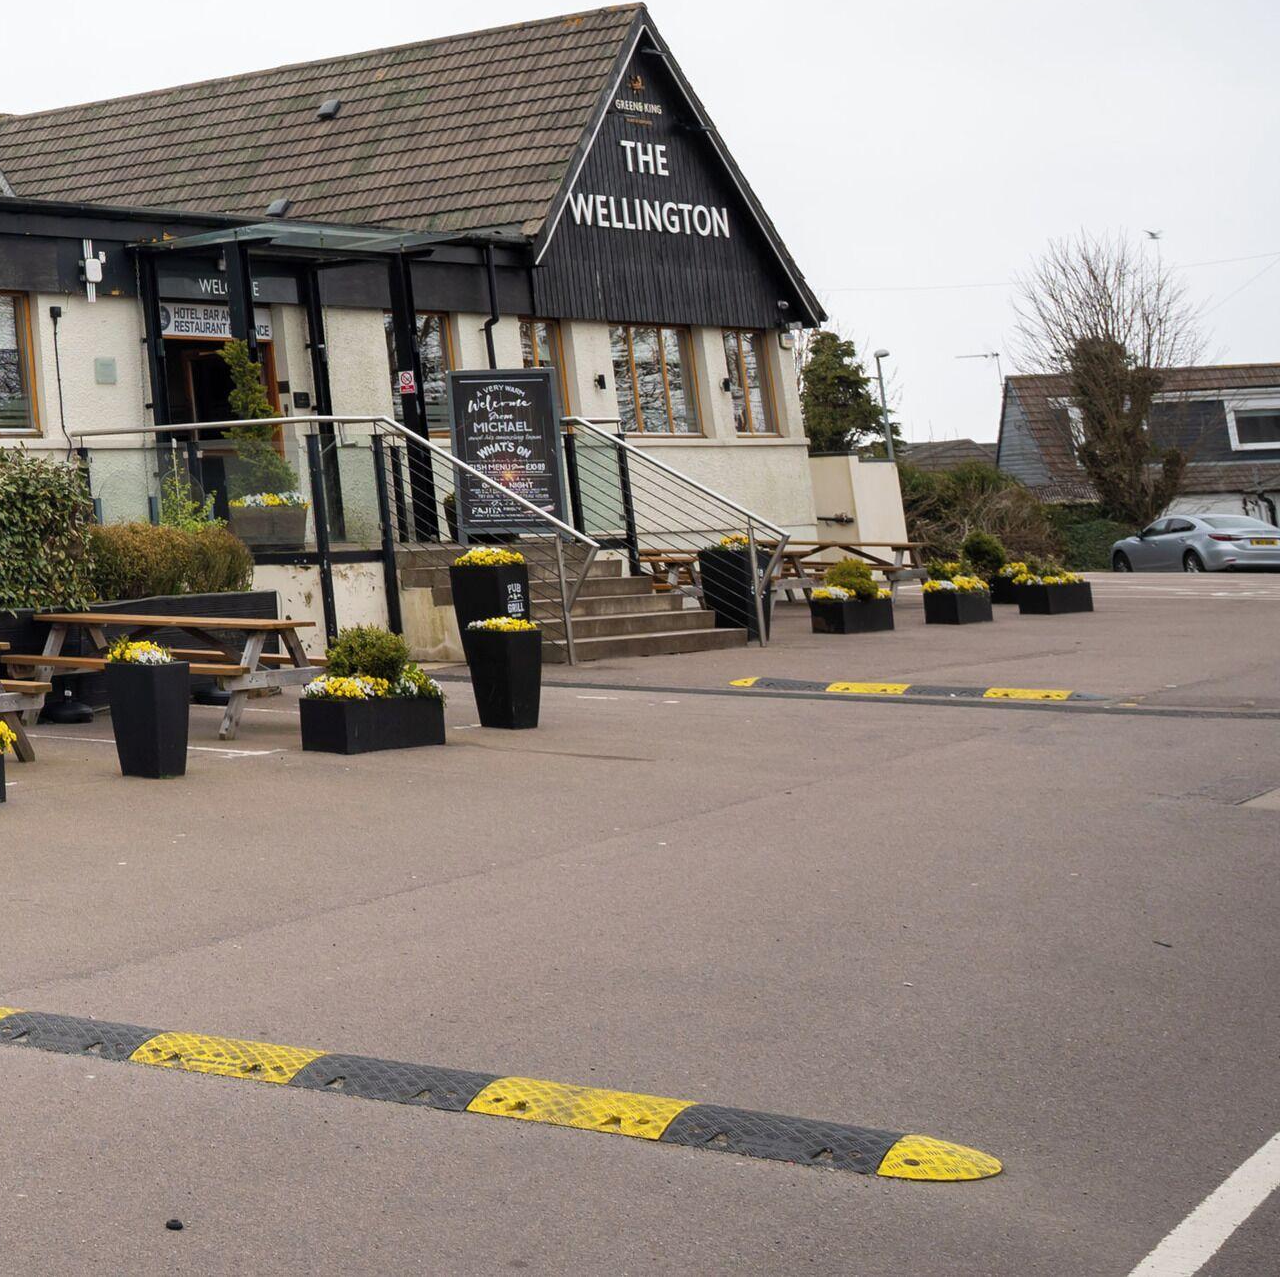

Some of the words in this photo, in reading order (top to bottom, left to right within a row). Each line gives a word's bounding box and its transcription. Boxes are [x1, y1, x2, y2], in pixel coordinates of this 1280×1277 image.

[644, 103, 662, 115] KING
[620, 140, 669, 176] THE
[569, 192, 730, 238] WELLINGTON
[199, 278, 259, 296] WELE
[203, 309, 219, 321] BAR
[174, 321, 226, 334] RESTAURANT
[483, 384, 504, 393] VERY
[505, 385, 525, 397] WARM
[468, 394, 532, 413] Welcome
[473, 421, 533, 433] MICHAEL
[477, 441, 515, 459] WHAT'S
[517, 446, 531, 458] ON
[507, 583, 521, 593] PUB
